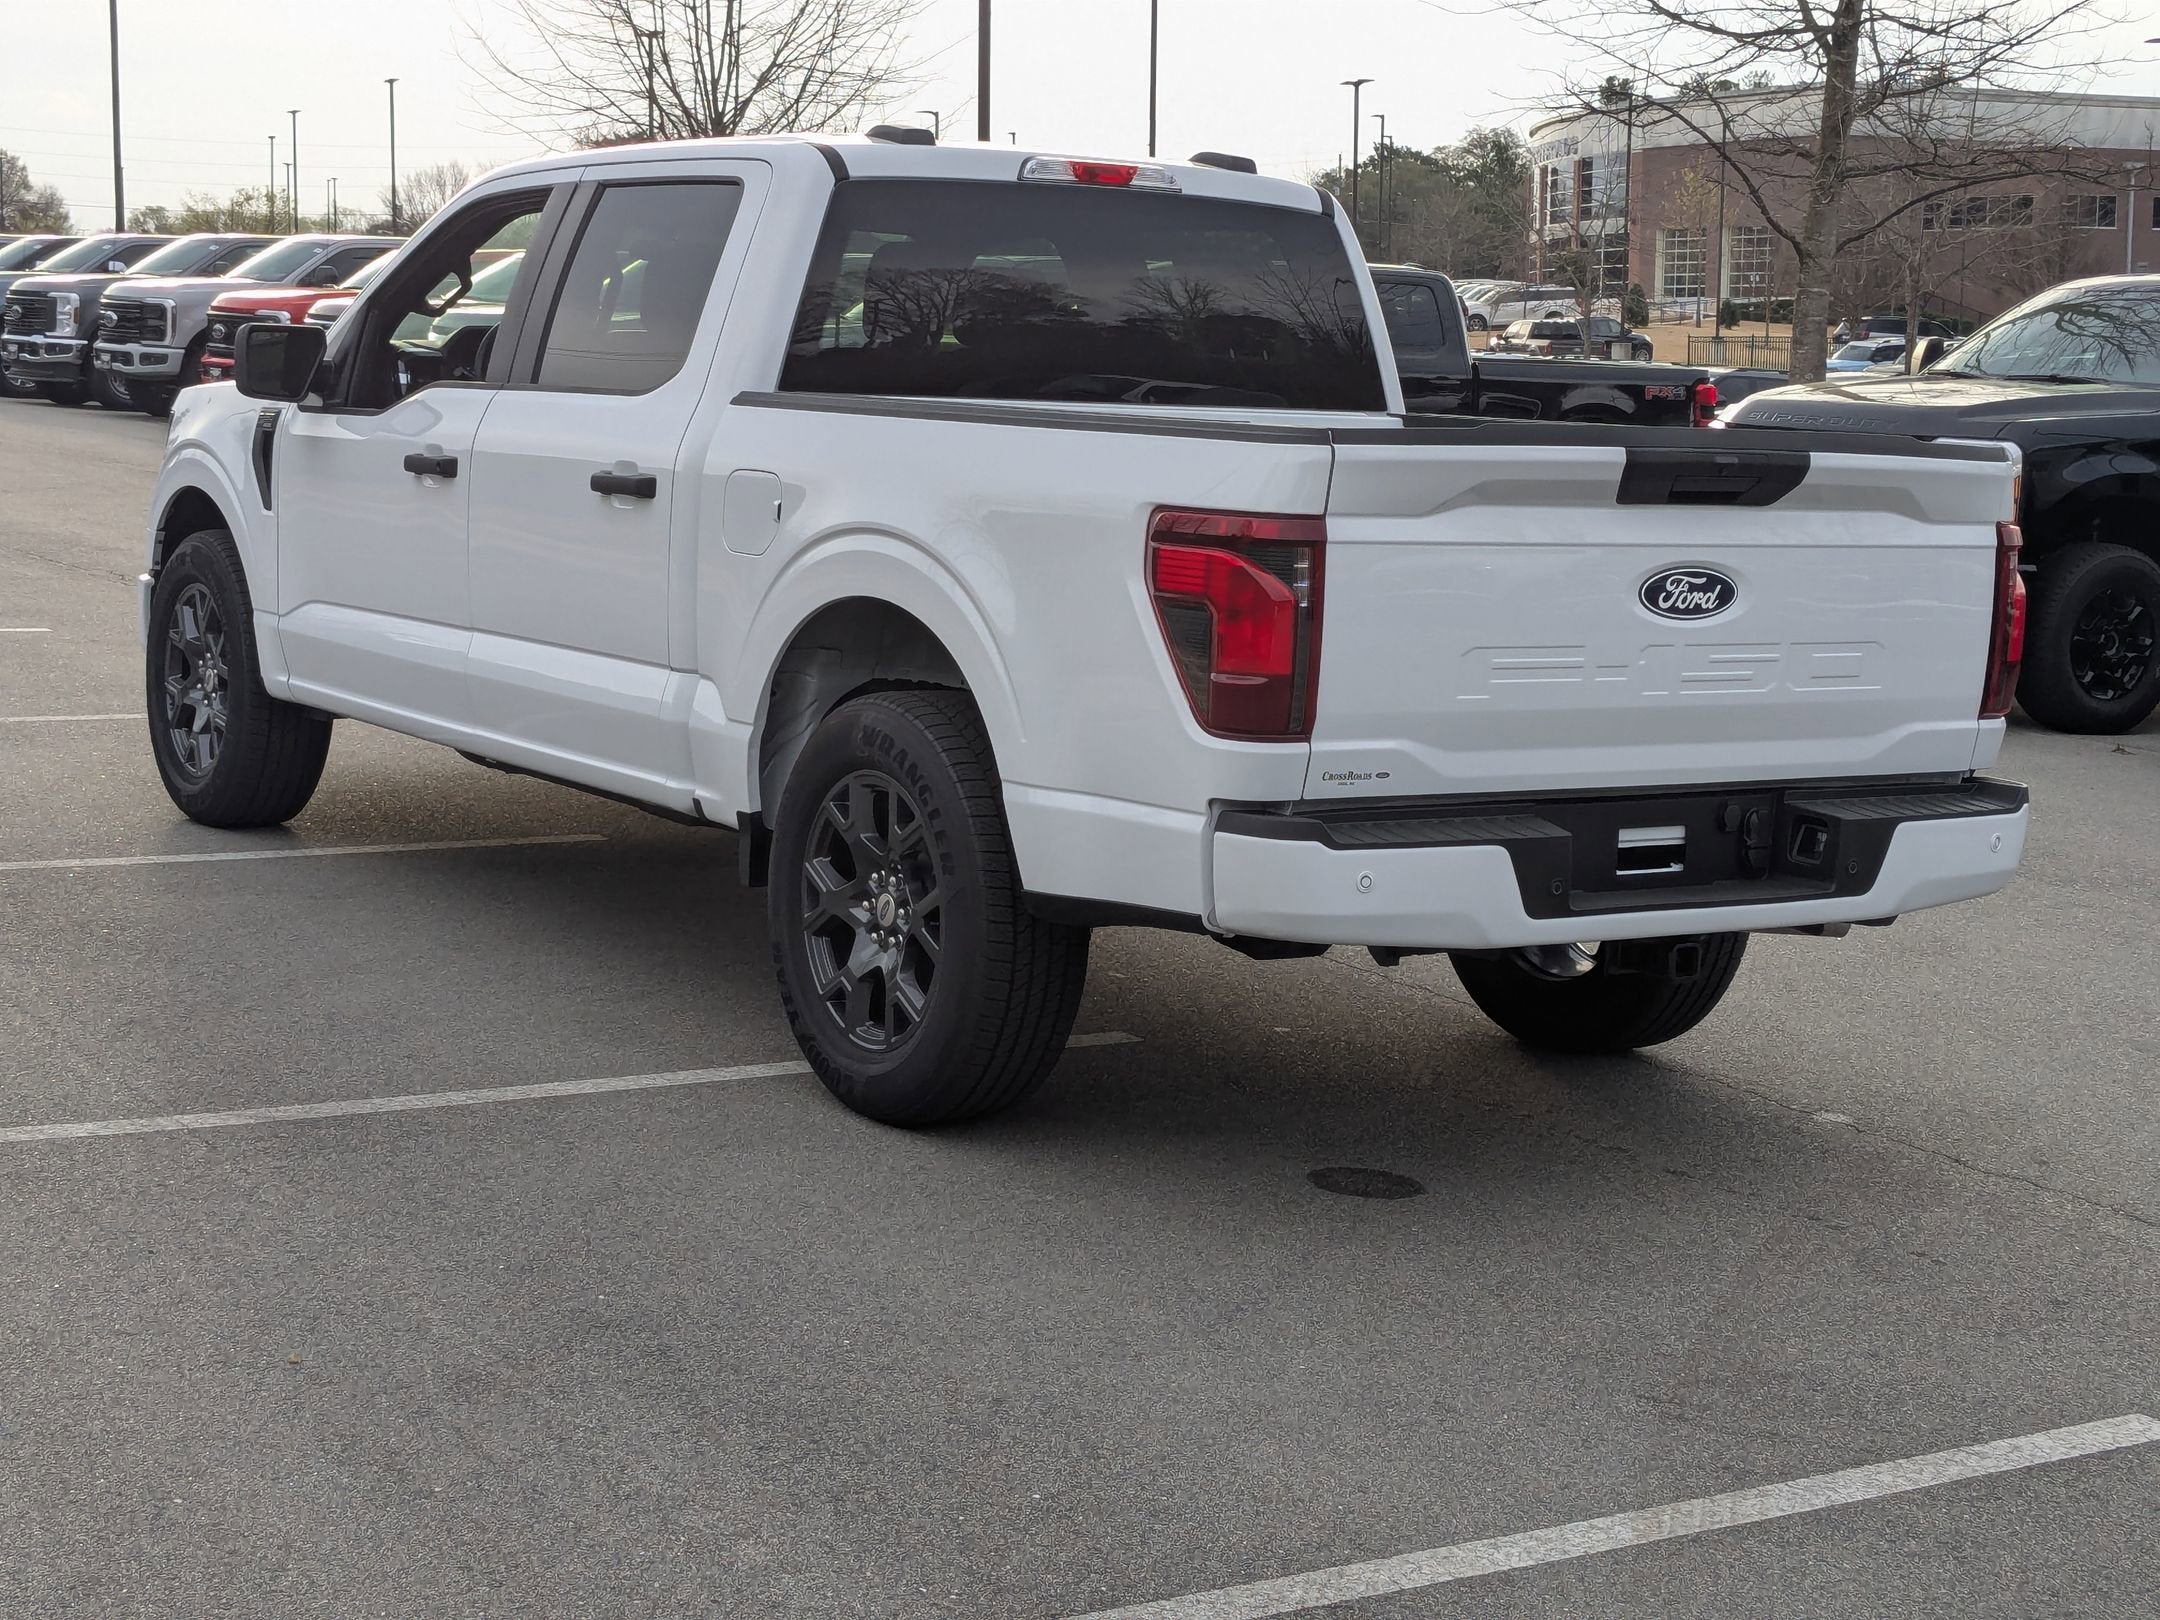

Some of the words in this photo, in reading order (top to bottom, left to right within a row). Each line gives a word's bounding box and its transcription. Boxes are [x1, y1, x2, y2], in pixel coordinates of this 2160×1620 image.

[1645, 385, 1686, 400] FX4
[1748, 410, 1824, 425] SUPER
[1659, 575, 1721, 609] Ford
[1457, 641, 1886, 699] F-150
[863, 724, 955, 876] WRANGLER
